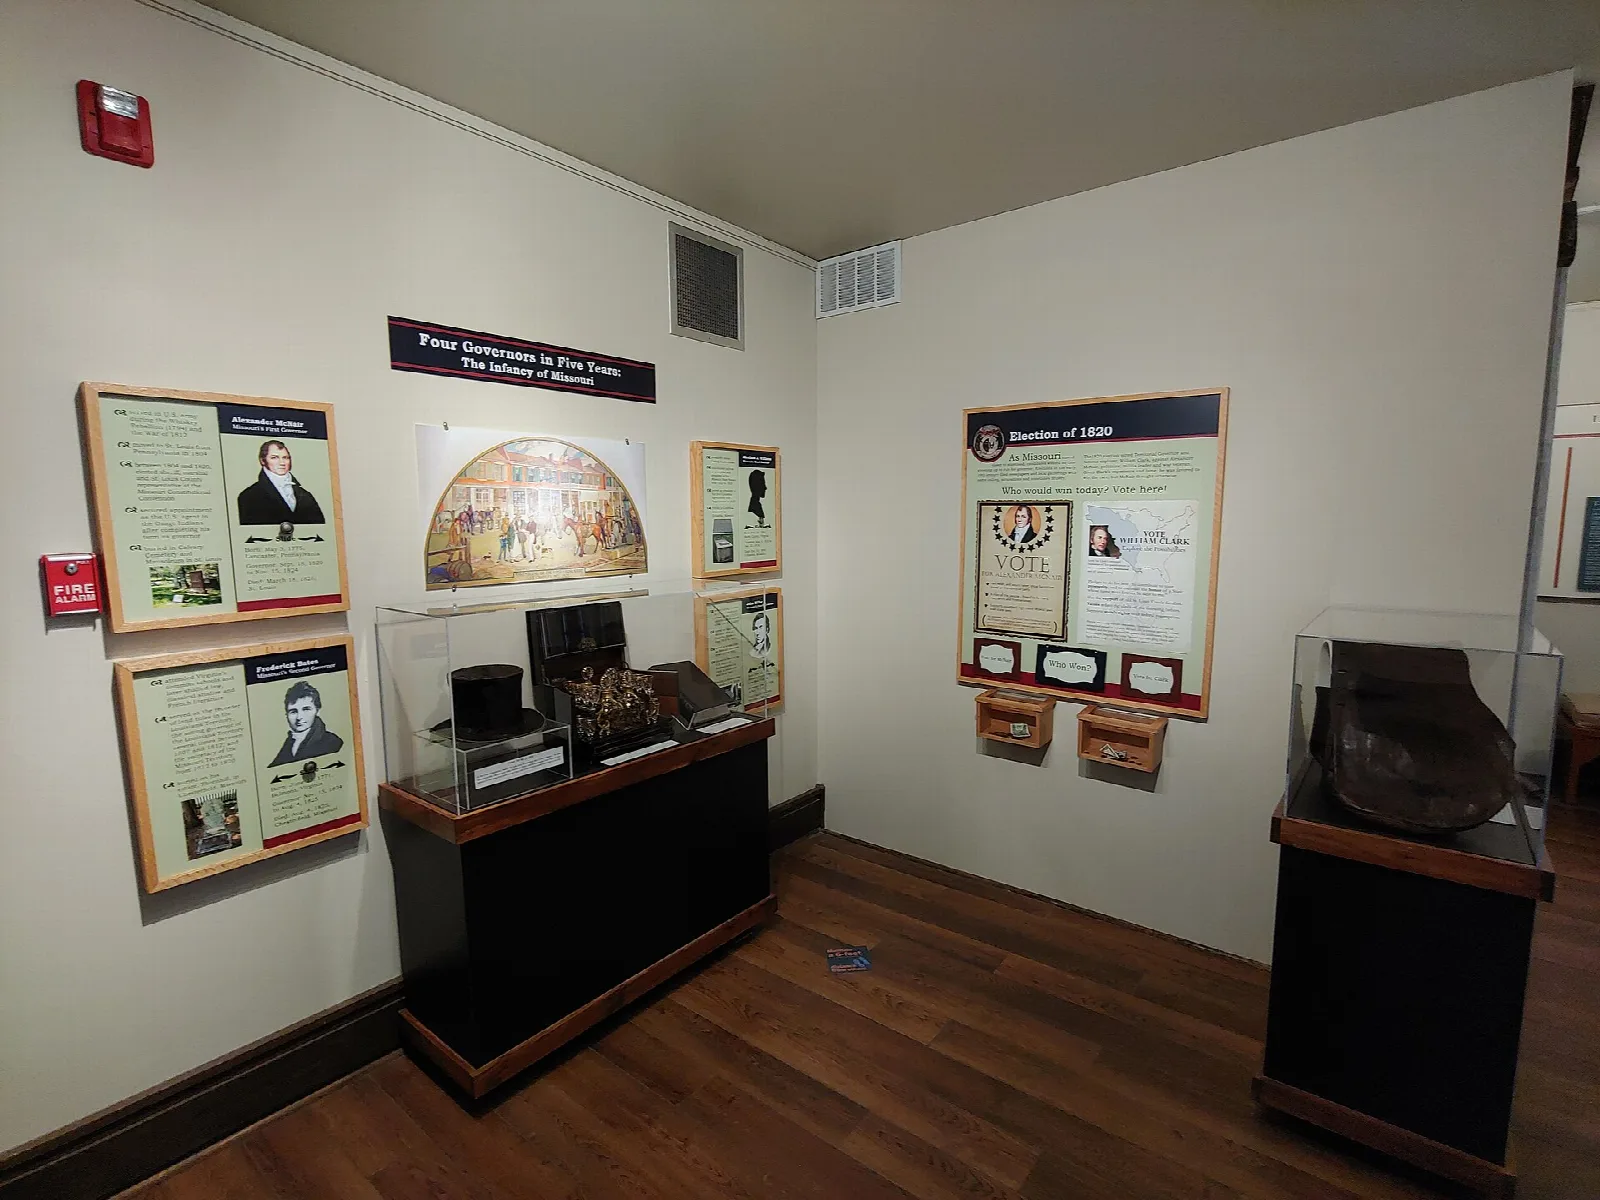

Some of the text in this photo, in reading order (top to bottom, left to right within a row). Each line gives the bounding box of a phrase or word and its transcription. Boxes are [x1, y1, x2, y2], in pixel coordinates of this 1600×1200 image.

[419, 332, 622, 378] Four Governors in Five Years:
[461, 357, 594, 386] The Infancy of Missouri
[232, 417, 304, 428] Alexander McNair
[1009, 426, 1113, 442] Election of 1820
[1009, 454, 1020, 462] As
[1022, 452, 1061, 461] Missouri
[1002, 485, 1168, 496] Who would win today? Vote here!
[994, 555, 1049, 573] VOTE
[54, 583, 95, 595] FIRE
[55, 594, 96, 603] ALARM
[256, 662, 296, 673] Frederick
[257, 670, 287, 679] Missouri's
[310, 663, 336, 671] Governor
[1049, 660, 1092, 672] Who Won?
